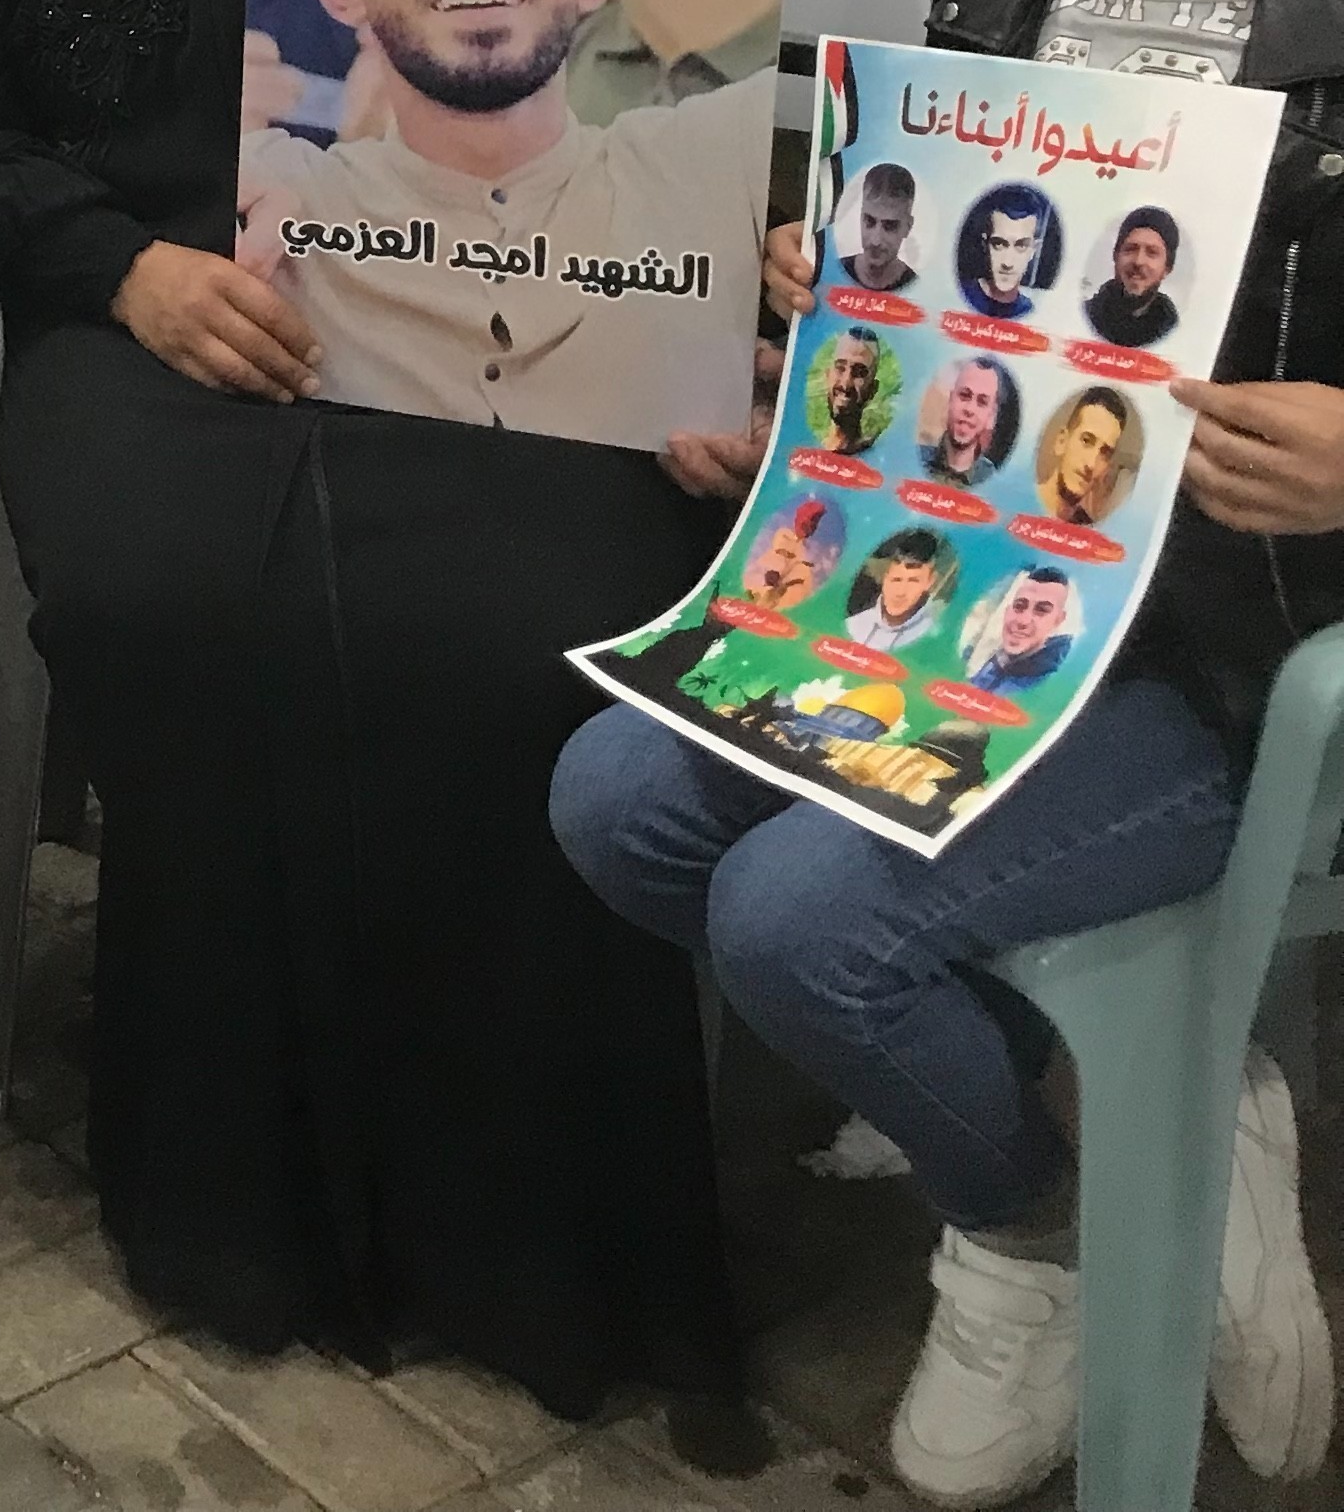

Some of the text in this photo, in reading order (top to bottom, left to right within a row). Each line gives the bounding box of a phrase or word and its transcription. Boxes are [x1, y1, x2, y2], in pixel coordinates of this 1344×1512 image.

[901, 83, 1182, 179] أعيدوا أبناءنا
[282, 221, 709, 298] الشهيد امجد العزمي
